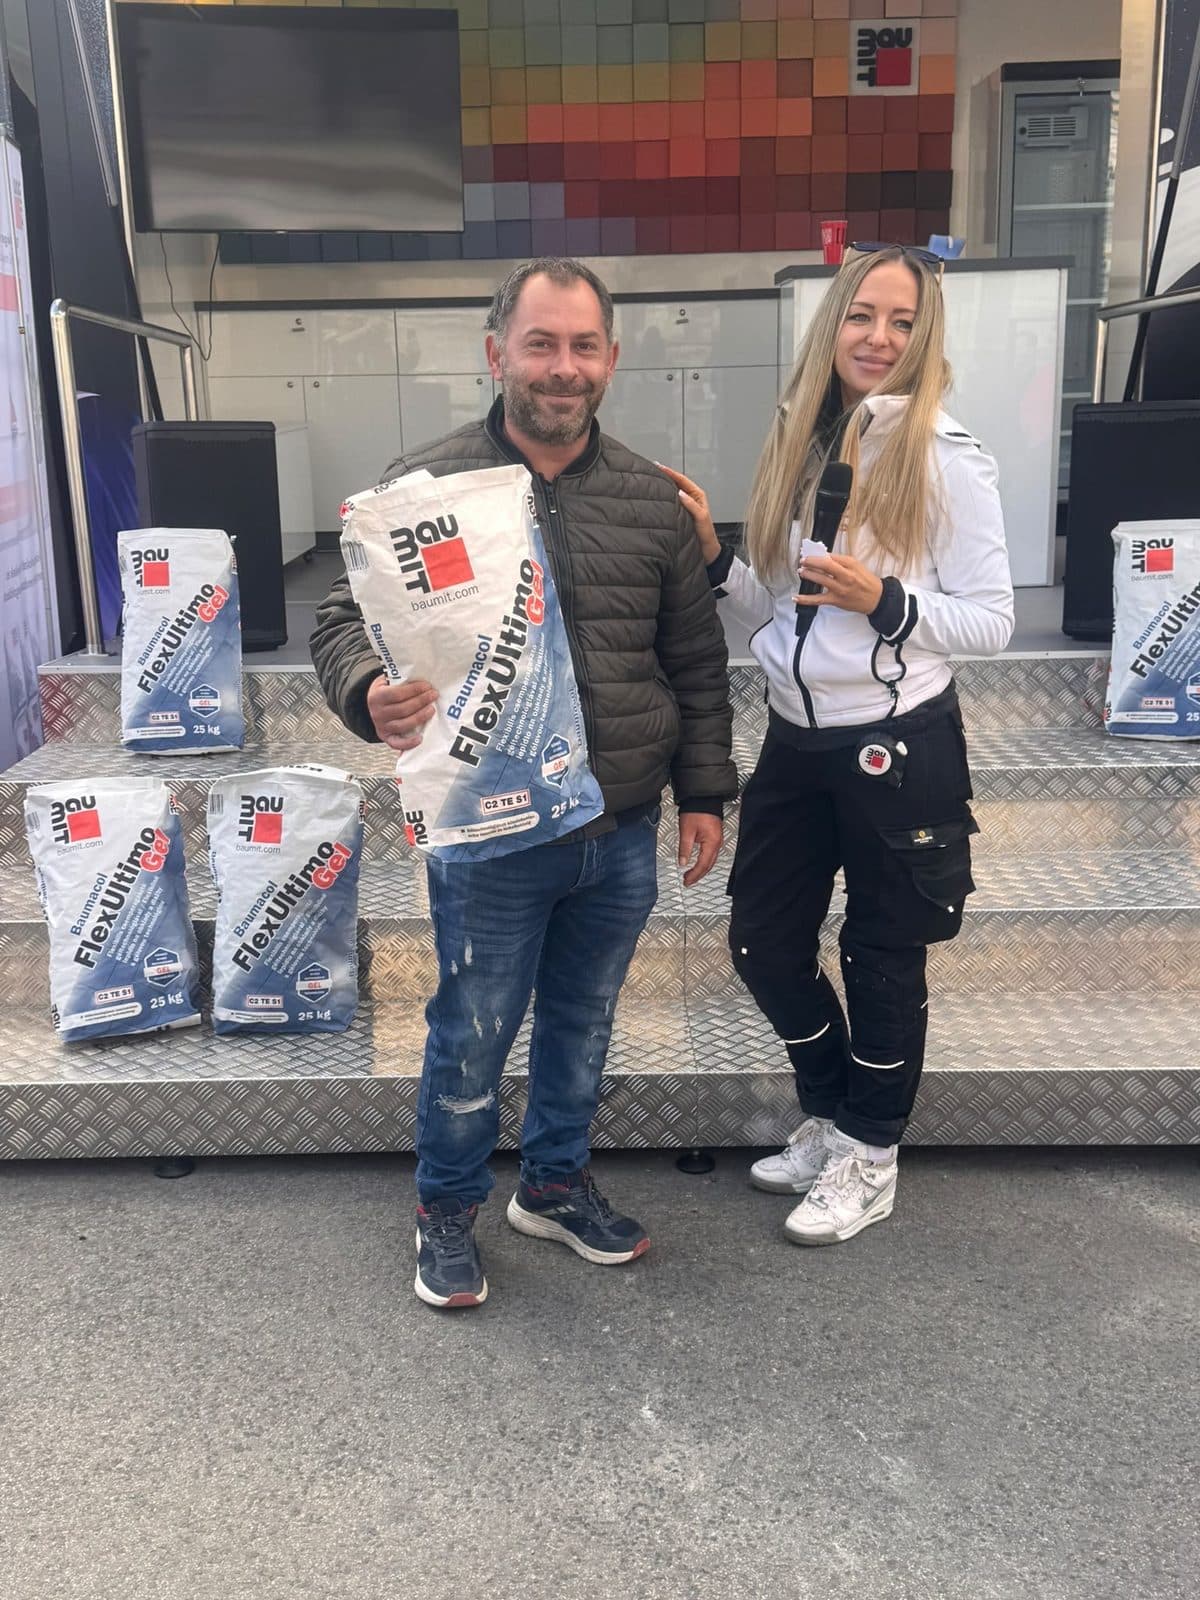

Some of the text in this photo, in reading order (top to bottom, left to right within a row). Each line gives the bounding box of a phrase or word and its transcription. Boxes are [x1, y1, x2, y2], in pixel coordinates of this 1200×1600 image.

[411, 585, 480, 611] baumit.com
[137, 583, 216, 694] FlexUltimo
[197, 585, 229, 623] Gel
[138, 616, 171, 667] Baumacol
[1133, 601, 1172, 650] Baumacol
[370, 623, 402, 680] Baumacol
[449, 559, 534, 767] FlexUltimo
[525, 559, 546, 625] Gel
[446, 634, 493, 721] Baumacol
[192, 724, 206, 735] 25
[207, 724, 221, 737] kg
[485, 794, 528, 810] C2 TE S1
[551, 801, 567, 819] 25
[71, 873, 108, 937] Baumacol
[74, 827, 156, 968] FlexUltimo
[139, 828, 171, 872] Gel
[232, 841, 335, 972] FlexUltimo
[312, 841, 352, 889] Gel
[233, 880, 279, 938] Baumacol
[110, 990, 121, 998] TE
[150, 991, 184, 1009] 25 kg
[297, 1011, 314, 1021] 25
[316, 1009, 331, 1021] kg
